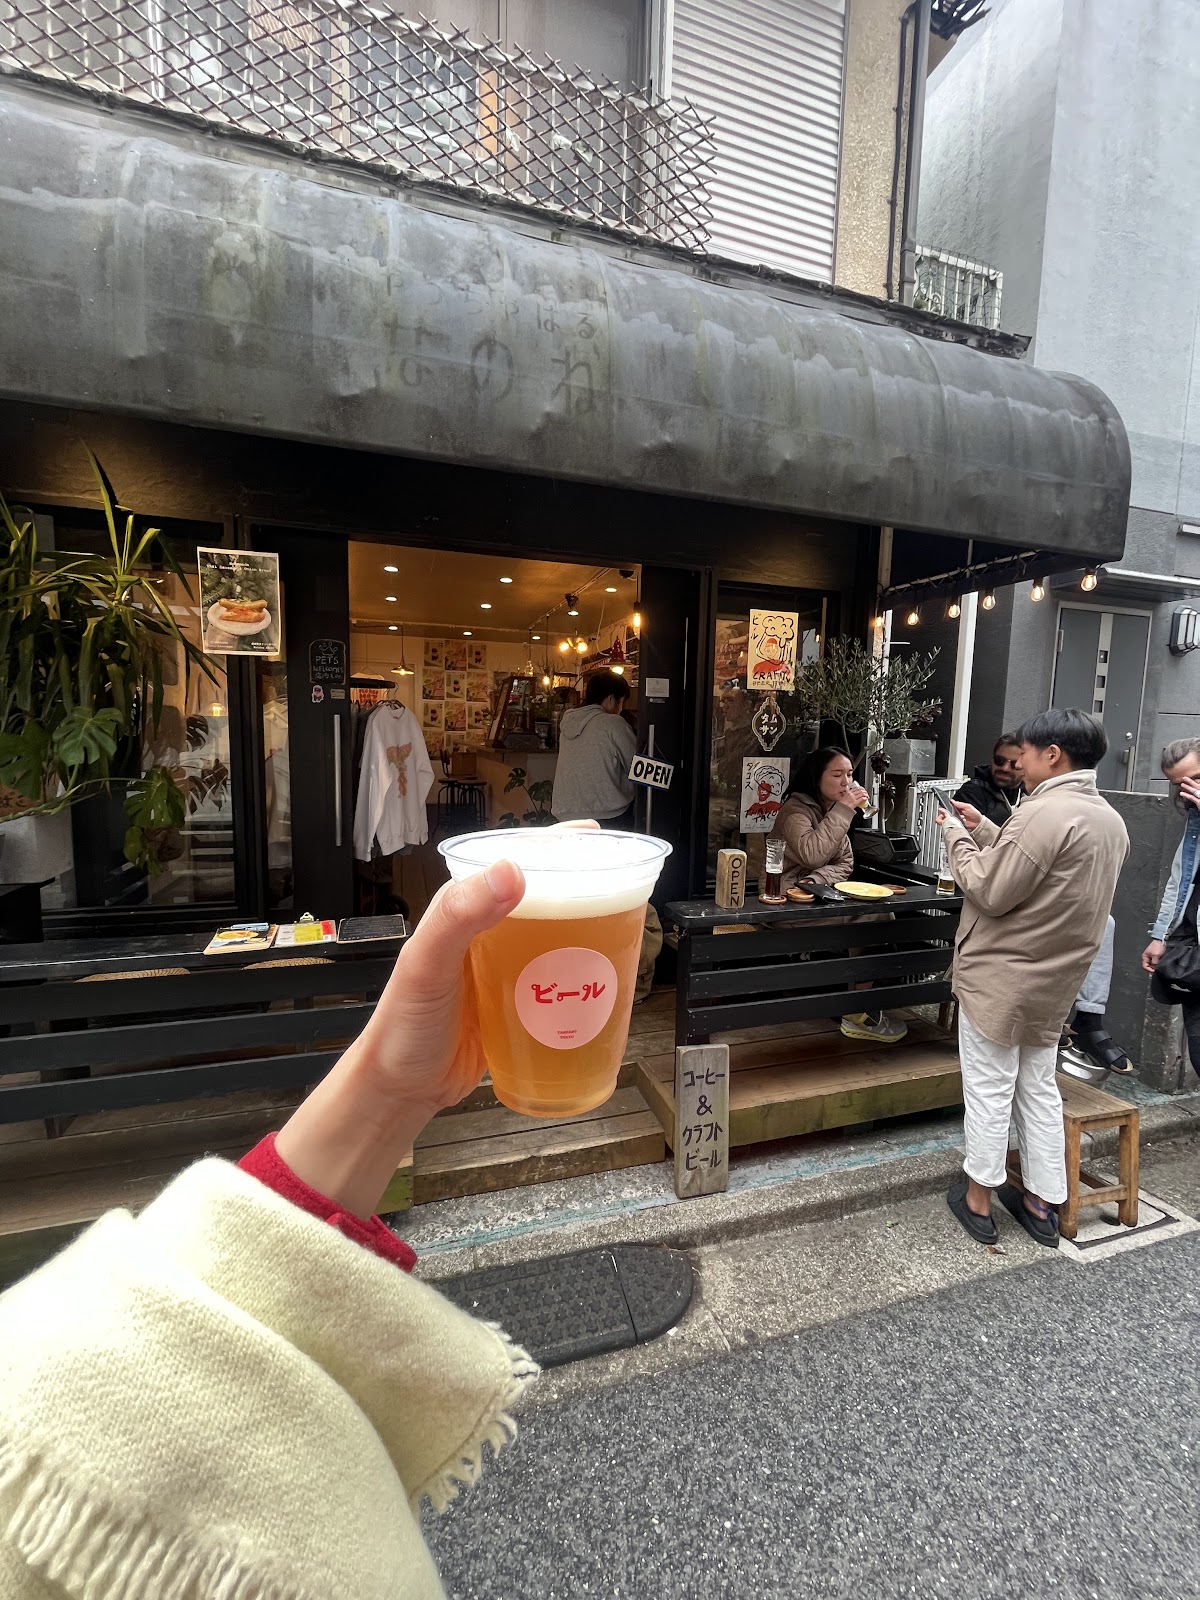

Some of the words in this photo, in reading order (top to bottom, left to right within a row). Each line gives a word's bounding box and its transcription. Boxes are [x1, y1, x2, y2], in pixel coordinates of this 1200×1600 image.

[315, 655, 339, 665] PETS
[759, 724, 778, 736] サン
[633, 760, 671, 786] OPEN
[730, 857, 743, 907] OPEN
[530, 981, 606, 1004] ビール
[683, 1067, 726, 1088] コーヒー
[696, 1094, 713, 1116] &
[682, 1121, 723, 1147] クラフト
[685, 1148, 722, 1172] ビール
